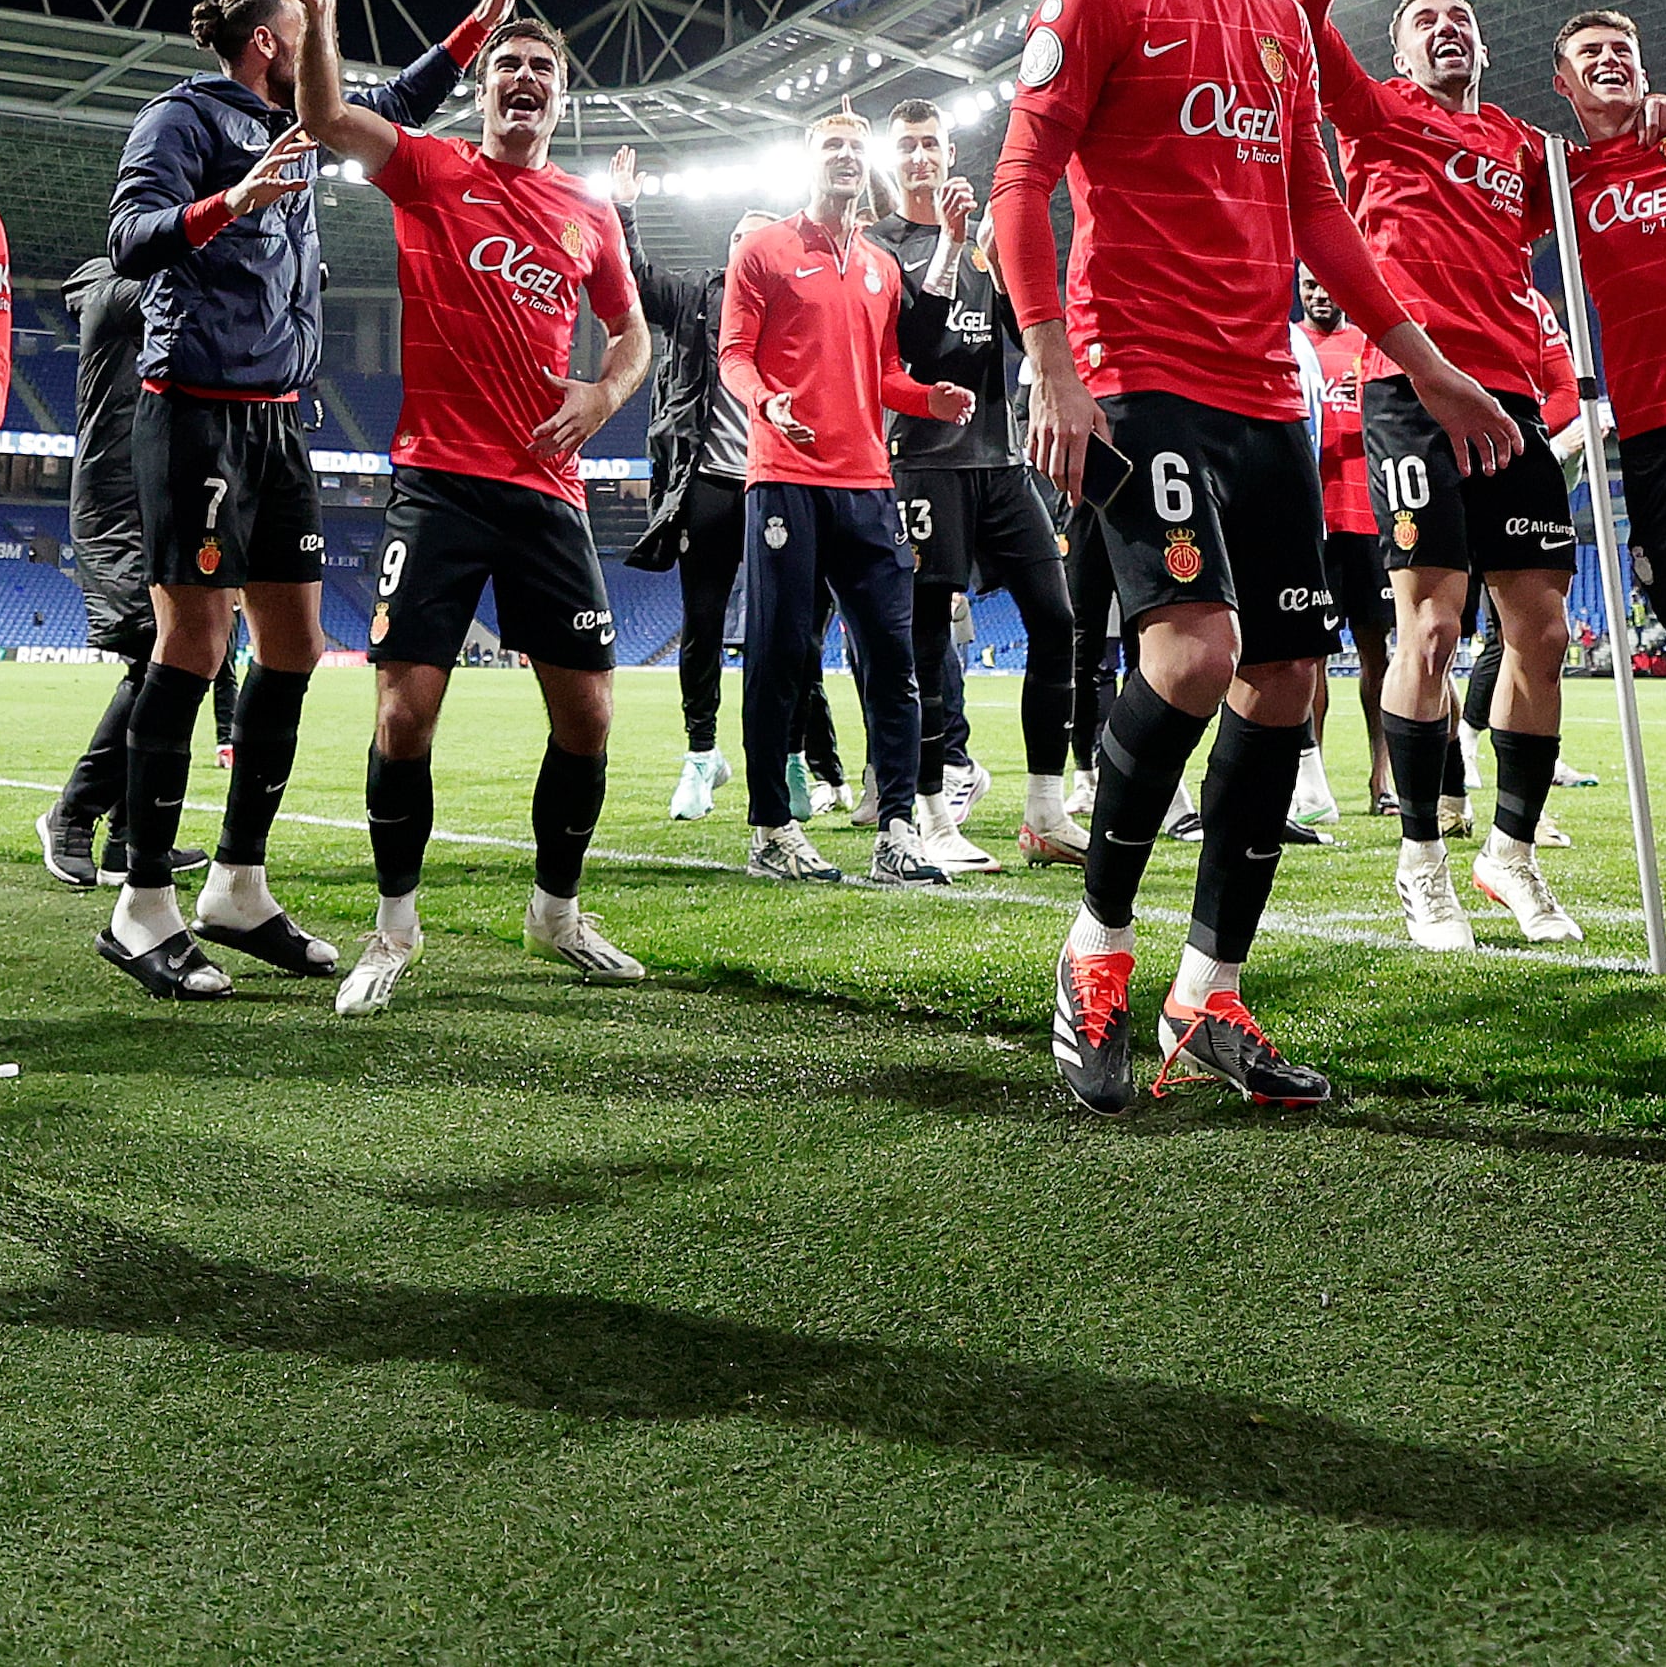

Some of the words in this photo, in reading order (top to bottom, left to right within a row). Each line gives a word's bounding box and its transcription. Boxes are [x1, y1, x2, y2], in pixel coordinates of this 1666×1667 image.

[1236, 142, 1250, 163] by
[1490, 194, 1504, 211] by
[1641, 221, 1656, 235] by
[511, 288, 527, 305] by
[1150, 451, 1193, 522] 6
[1380, 454, 1431, 512] 10
[202, 477, 228, 529] 7
[378, 539, 407, 597] 9
